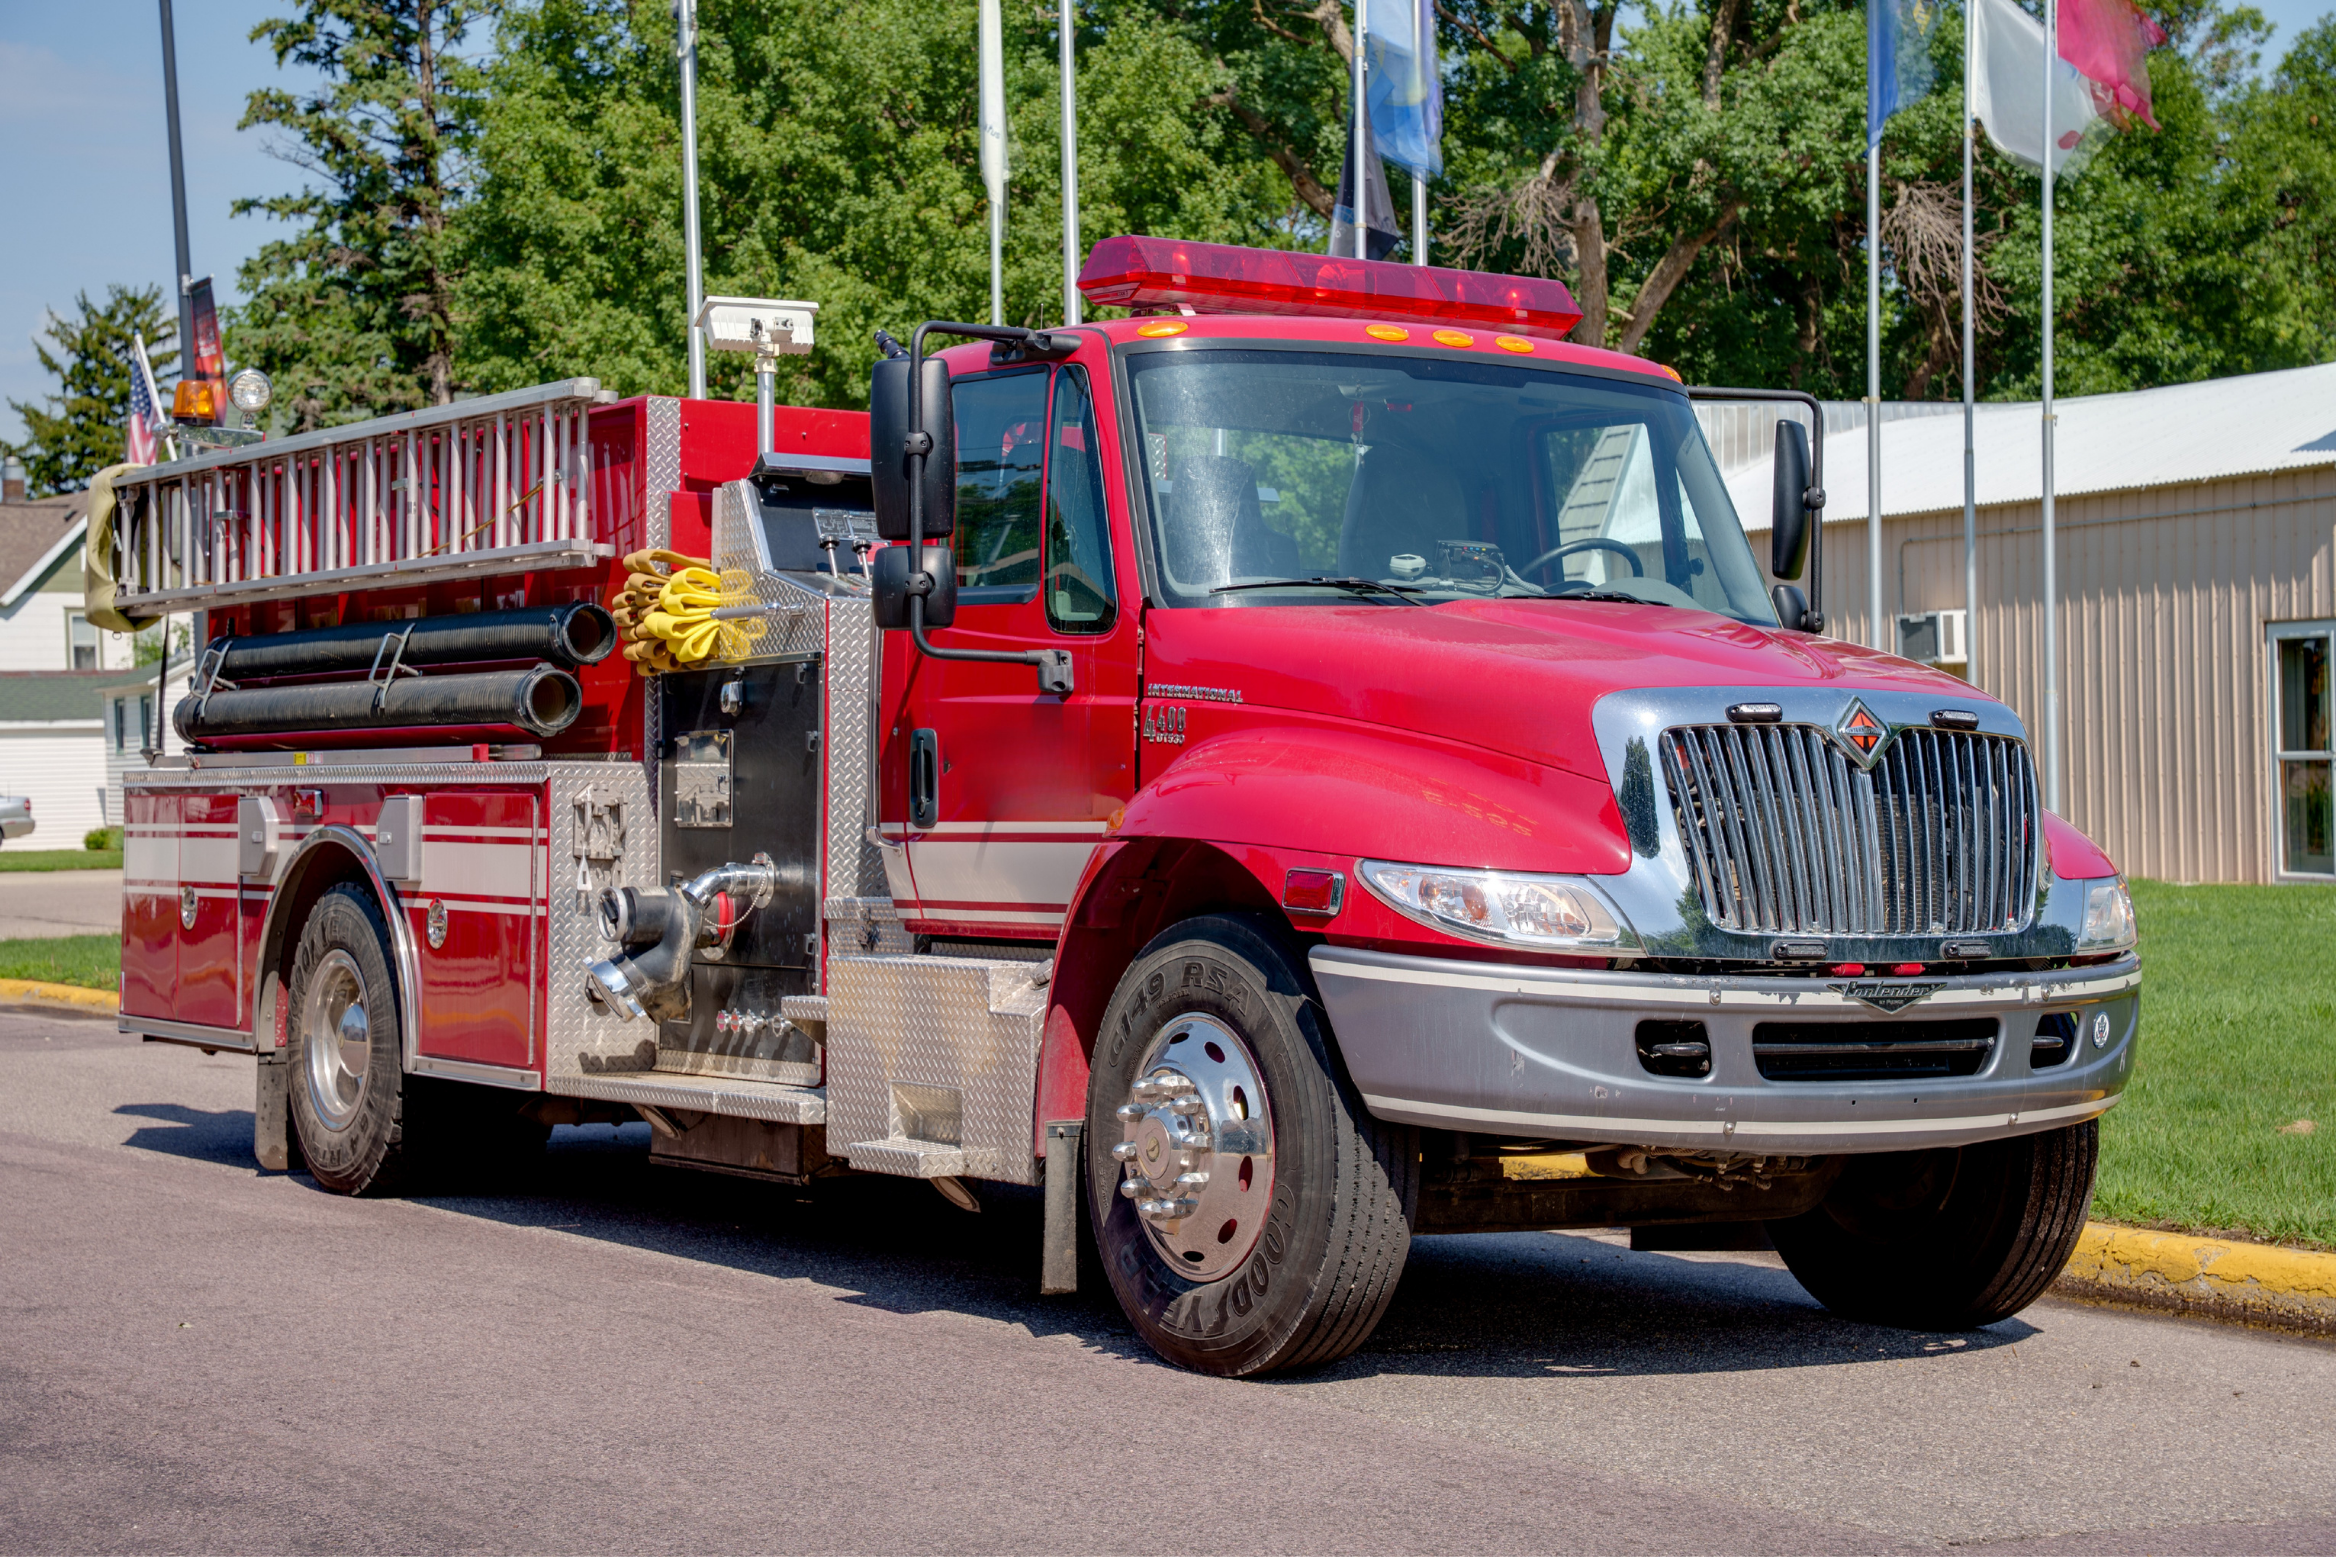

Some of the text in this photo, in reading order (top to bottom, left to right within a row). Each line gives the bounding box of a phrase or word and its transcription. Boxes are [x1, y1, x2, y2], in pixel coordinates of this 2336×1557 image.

[1148, 684, 1243, 702] INTERNATIONAL
[1143, 705, 1187, 742] 4400
[1842, 980, 1930, 998] Contender
[1107, 970, 1167, 1068] G149
[1180, 961, 1253, 1018] RSA
[1119, 1182, 1297, 1338] GOODYEAR
